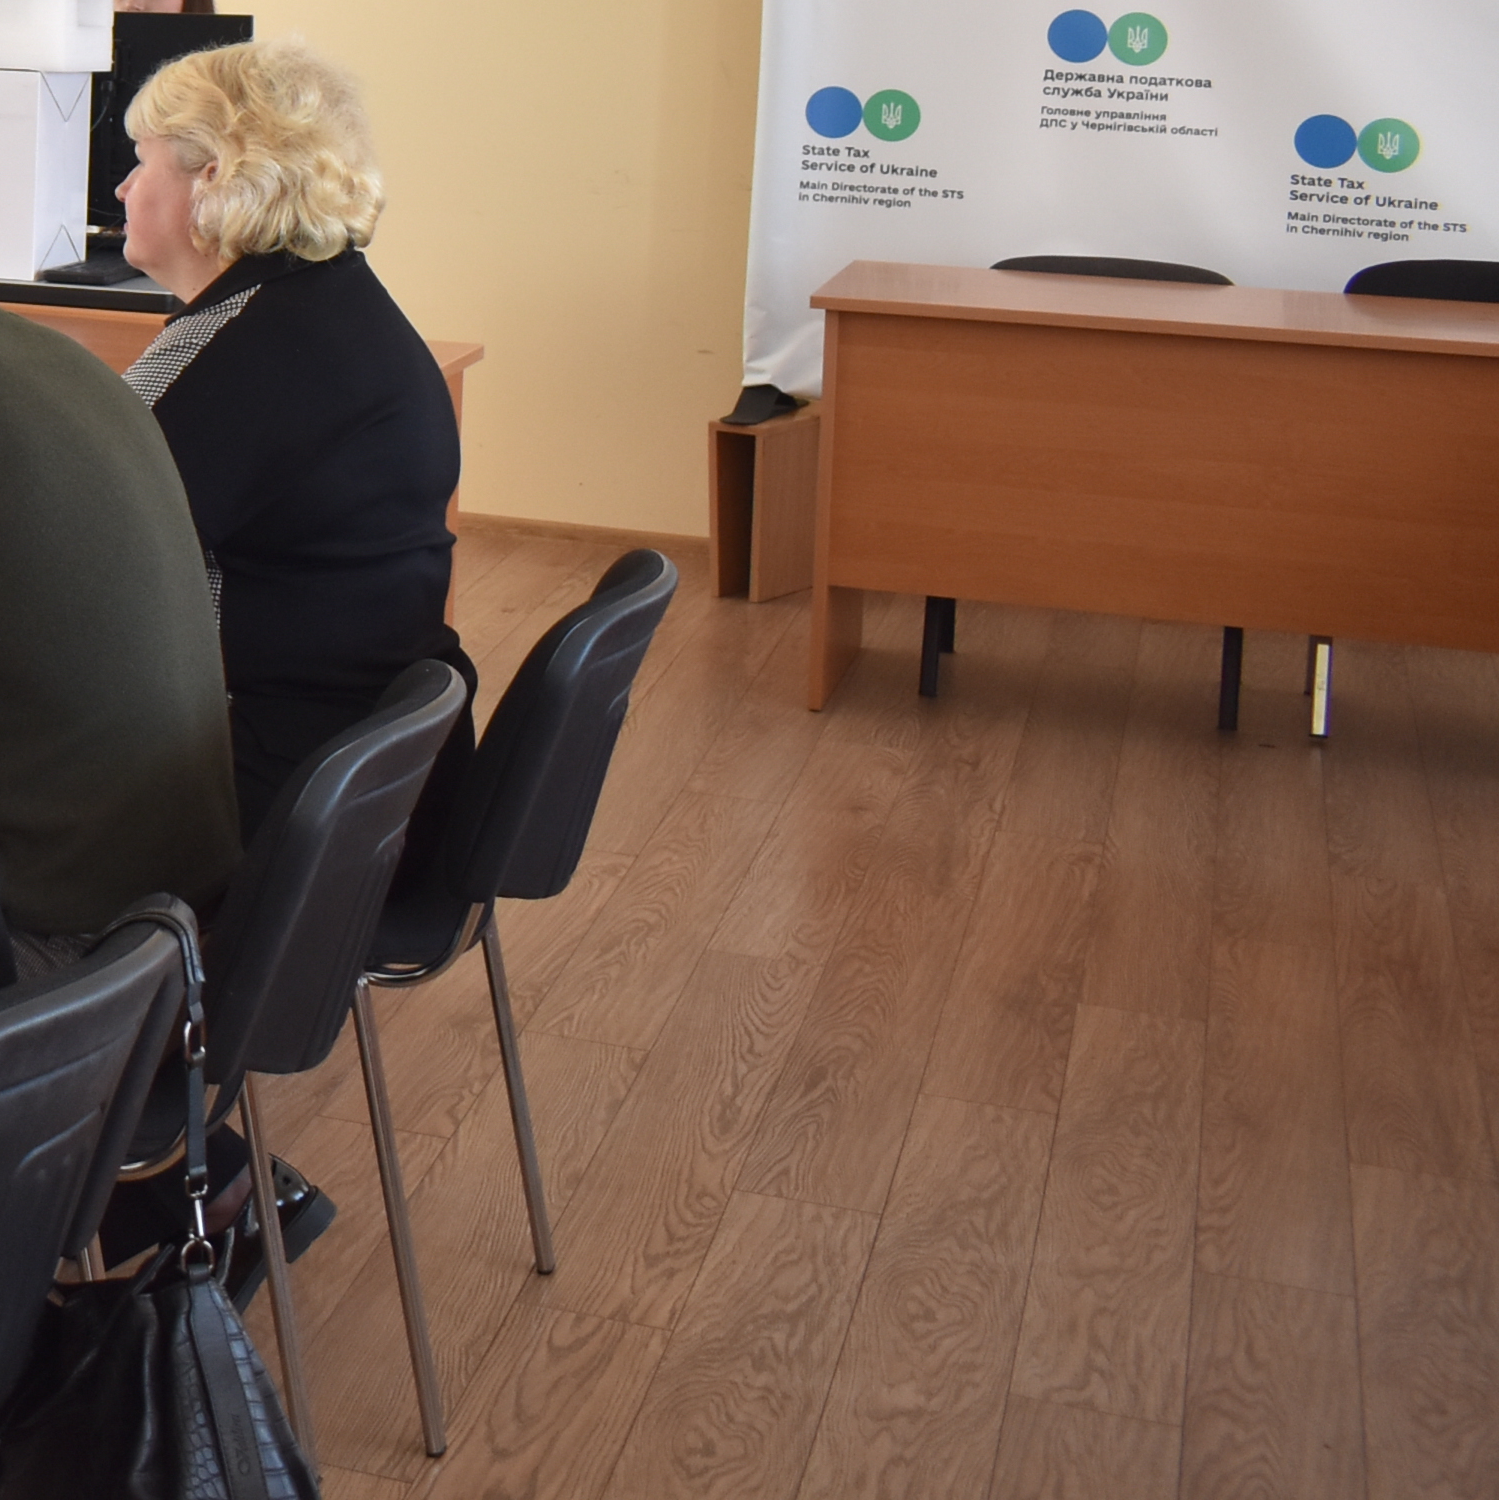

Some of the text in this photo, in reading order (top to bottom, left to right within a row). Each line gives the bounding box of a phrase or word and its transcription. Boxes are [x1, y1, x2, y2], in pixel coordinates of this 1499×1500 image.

[1042, 68, 1213, 89] Державна податкова
[1042, 85, 1169, 103] служба України
[1040, 105, 1167, 122] Головне управління
[1039, 117, 1219, 137] ДПС у Чернігівській області
[801, 144, 870, 159] State Tax
[801, 159, 938, 179] Service of Ukraine
[799, 180, 965, 200] Main Directorate of the STS
[1289, 173, 1365, 191] State Tax
[798, 191, 912, 209] in Chernihiv region
[1288, 189, 1439, 211] Service of Ukraine
[1286, 210, 1468, 234] Main Directorate of the STS
[1285, 223, 1410, 243] in Chernihiv region
